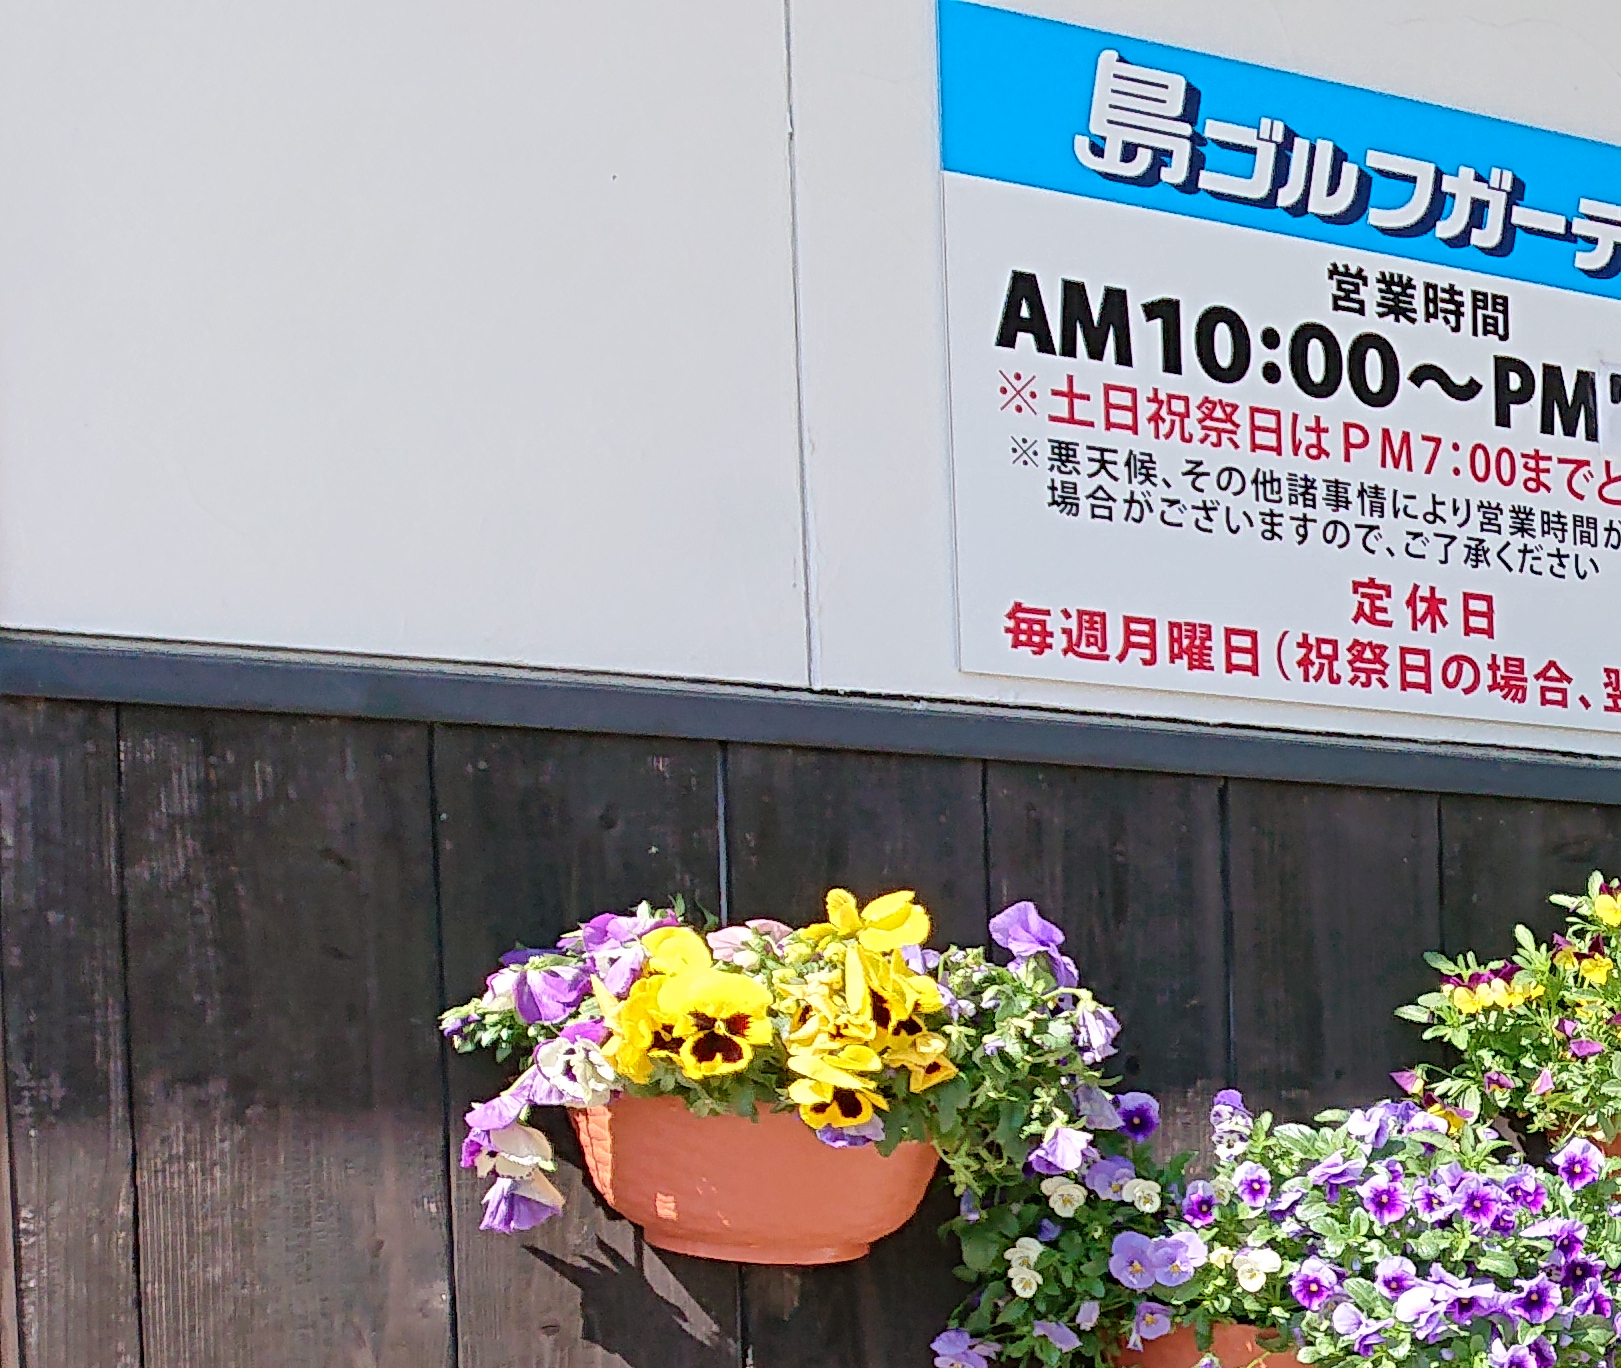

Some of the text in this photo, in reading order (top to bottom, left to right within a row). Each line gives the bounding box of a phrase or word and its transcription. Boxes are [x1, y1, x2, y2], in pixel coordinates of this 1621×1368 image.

[1327, 261, 1511, 342] 営業時間
[1046, 478, 1600, 581] 場合がございますので、ご了承ください
[1350, 576, 1496, 640] 定休日
